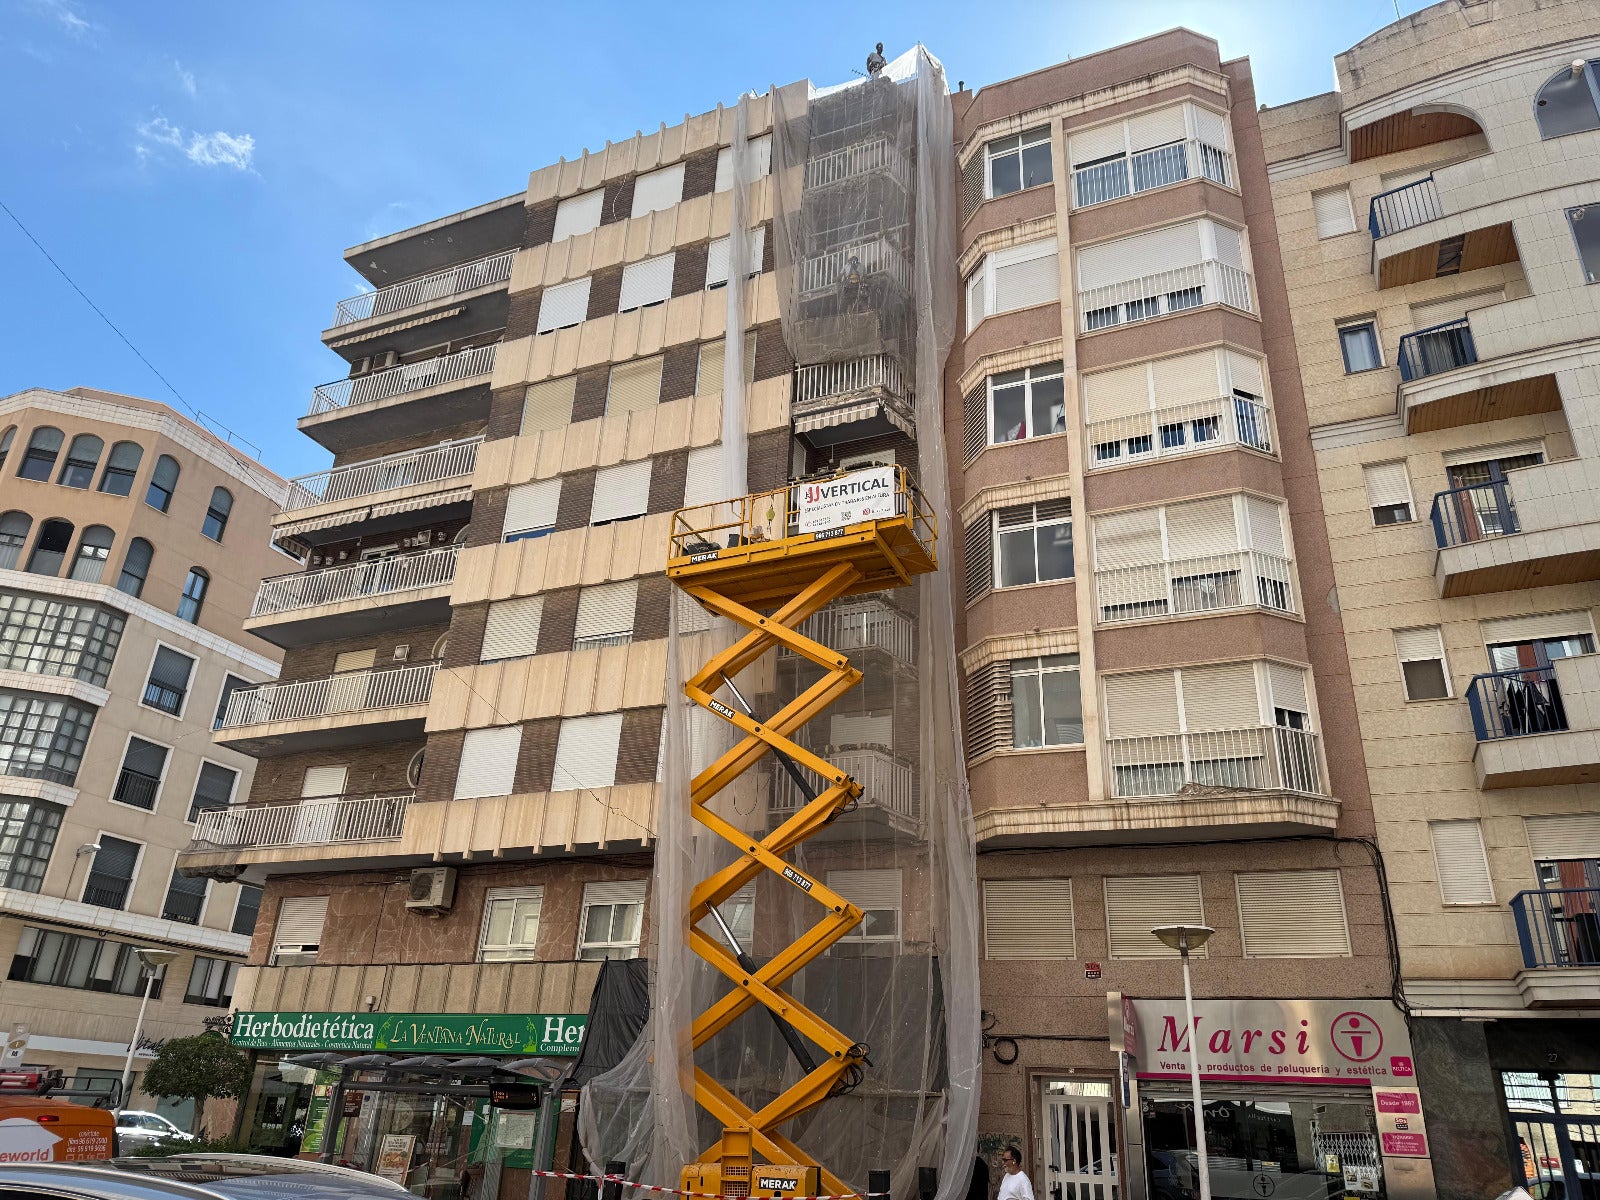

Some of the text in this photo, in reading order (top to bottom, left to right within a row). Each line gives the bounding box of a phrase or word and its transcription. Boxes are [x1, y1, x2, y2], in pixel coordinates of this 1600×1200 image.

[691, 552, 718, 563] MERAK
[710, 700, 734, 718] MERAK
[234, 1013, 374, 1039] Herbodietética
[410, 1022, 463, 1046] VENTANA
[465, 1018, 521, 1049] NATURAL
[1157, 1015, 1310, 1054] Marsi
[271, 1038, 297, 1048] Alimentos
[297, 1039, 321, 1048] Naturales
[324, 1039, 351, 1049] Cosmética
[351, 1040, 373, 1049] Natural
[1548, 1053, 1558, 1063] 27
[1160, 1061, 1186, 1070] Venta
[1207, 1062, 1255, 1073] productos
[1260, 1063, 1272, 1072] de
[1277, 1063, 1330, 1075] peluquería
[1335, 1067, 1341, 1076] y
[1346, 1066, 1387, 1075] estética
[0, 1149, 49, 1161] eworld
[760, 1179, 797, 1190] MERAK
